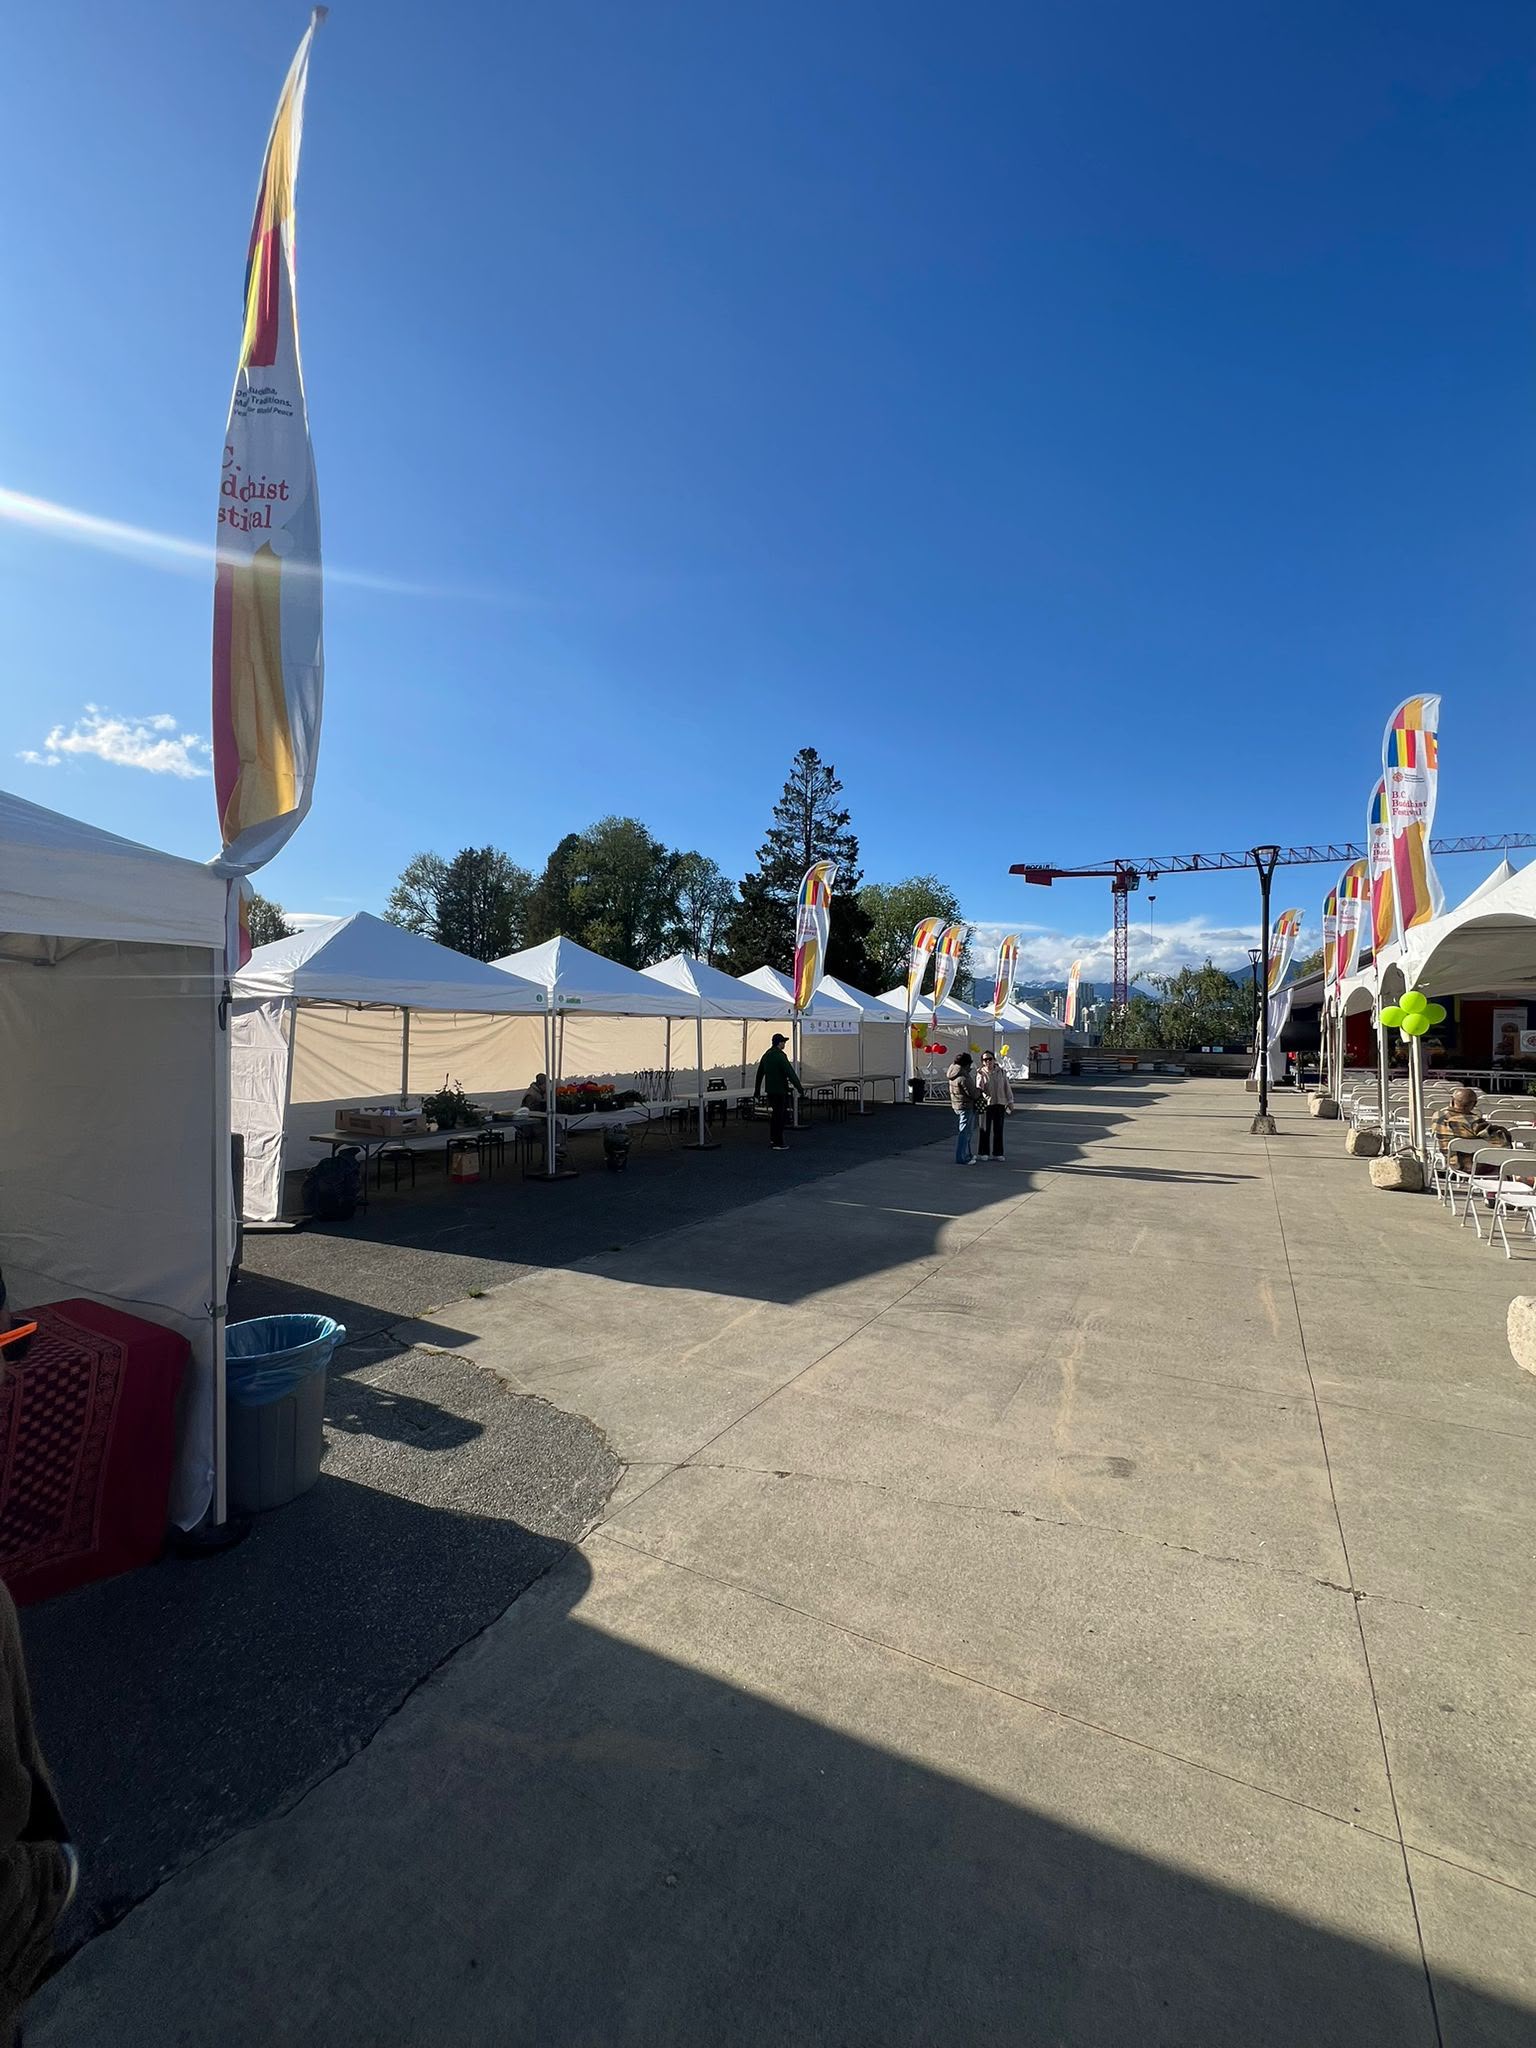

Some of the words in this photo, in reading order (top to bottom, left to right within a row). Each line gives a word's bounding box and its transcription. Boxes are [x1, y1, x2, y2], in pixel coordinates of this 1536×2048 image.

[222, 445, 242, 471] C.
[221, 473, 289, 503] ddhist
[217, 504, 272, 532] stial
